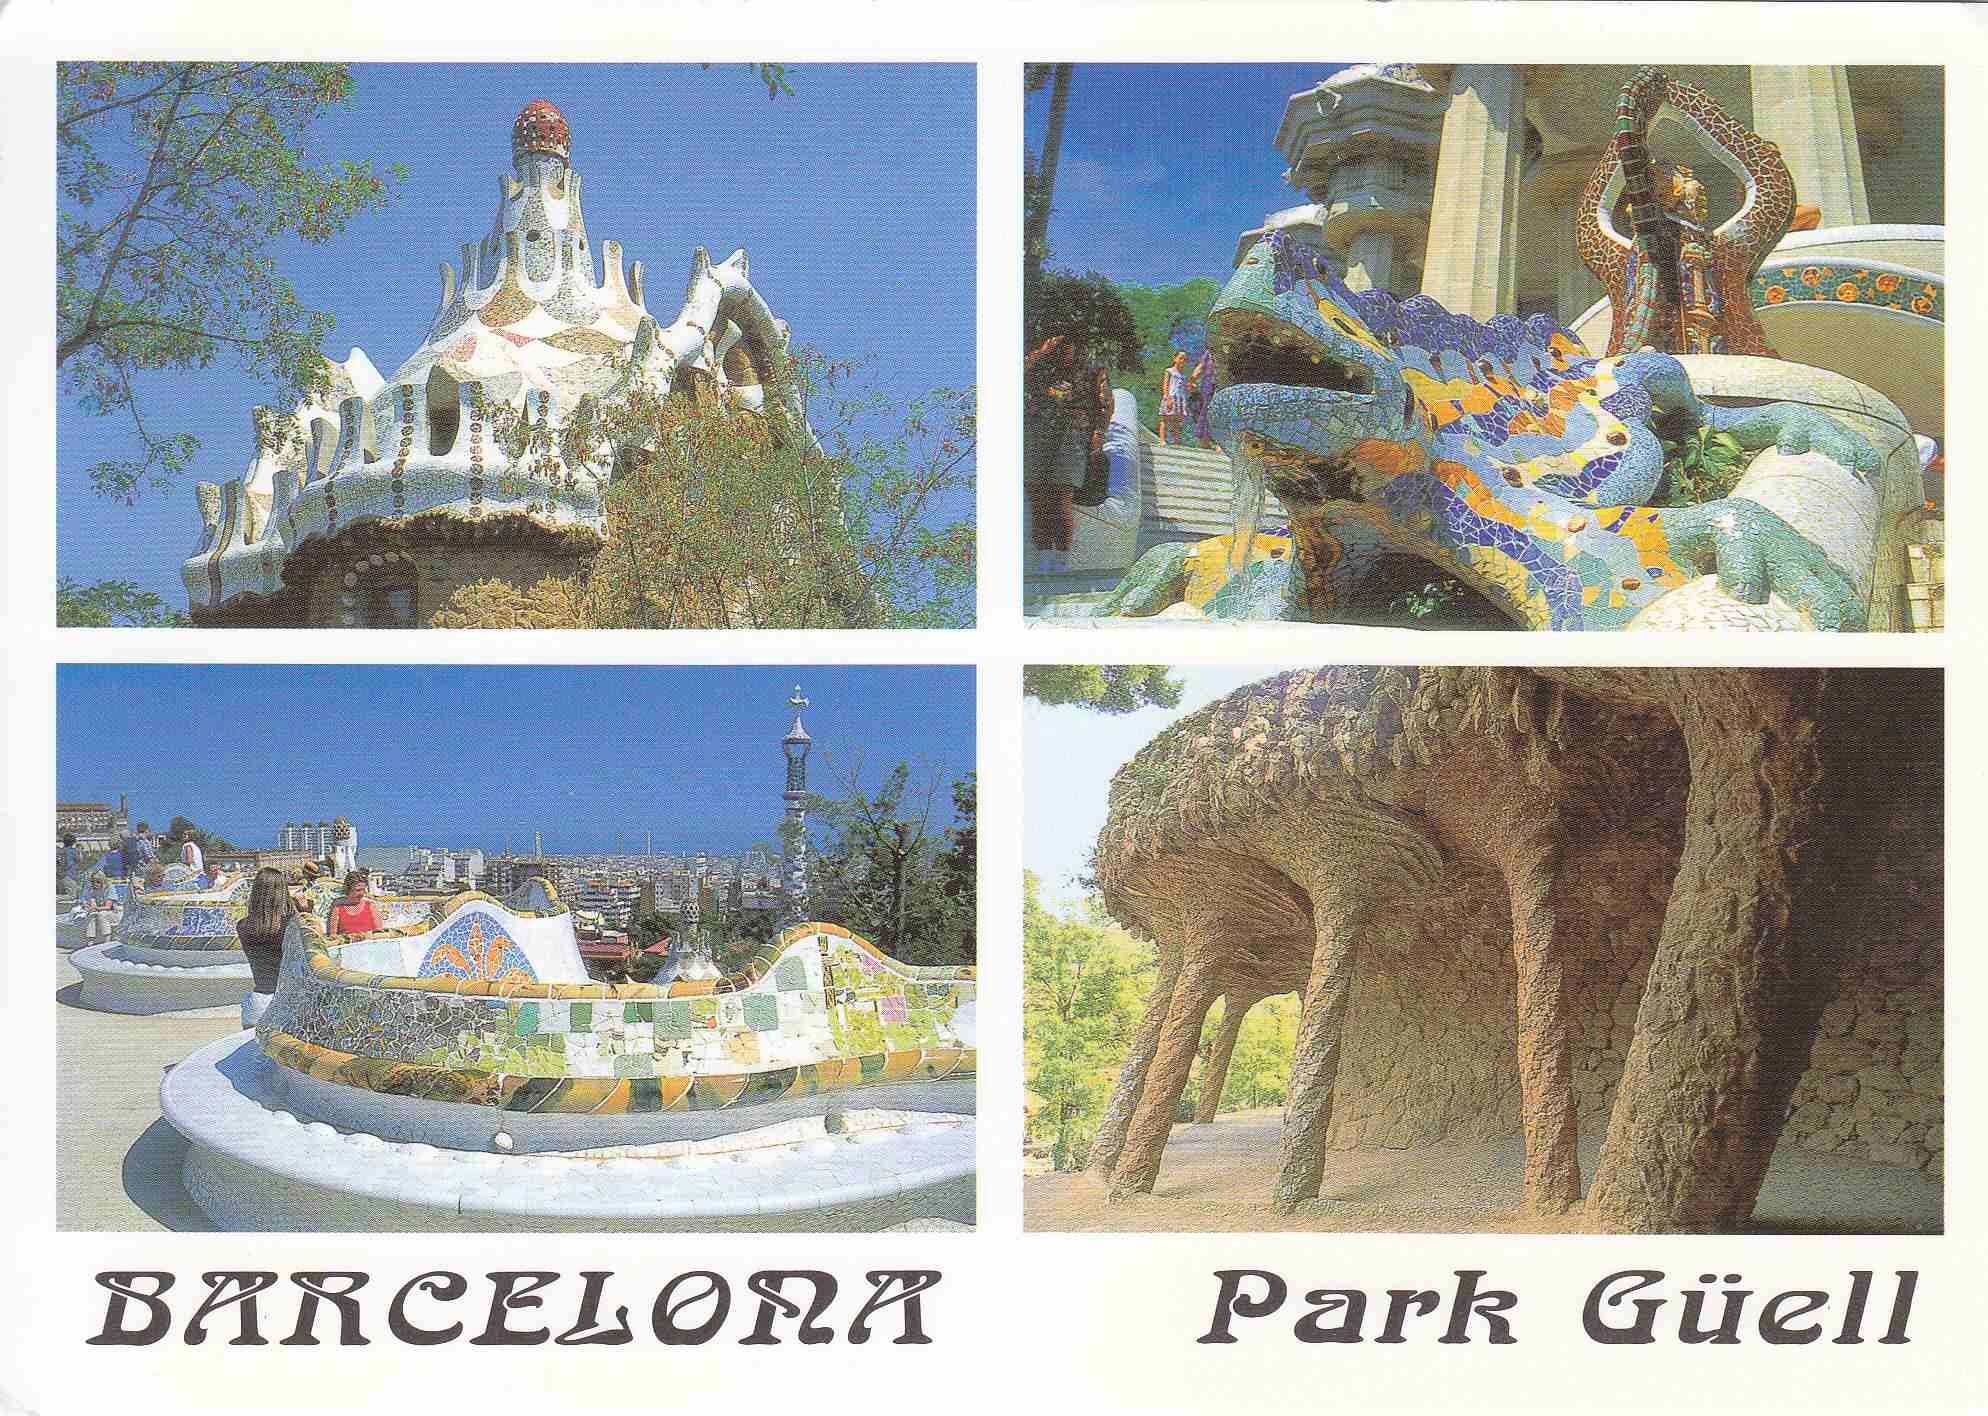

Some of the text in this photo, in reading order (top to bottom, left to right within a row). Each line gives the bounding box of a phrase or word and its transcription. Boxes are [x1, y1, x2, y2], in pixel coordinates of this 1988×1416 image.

[86, 1270, 941, 1346] BARCELONA
[1196, 1269, 1918, 1344] Park Güell
